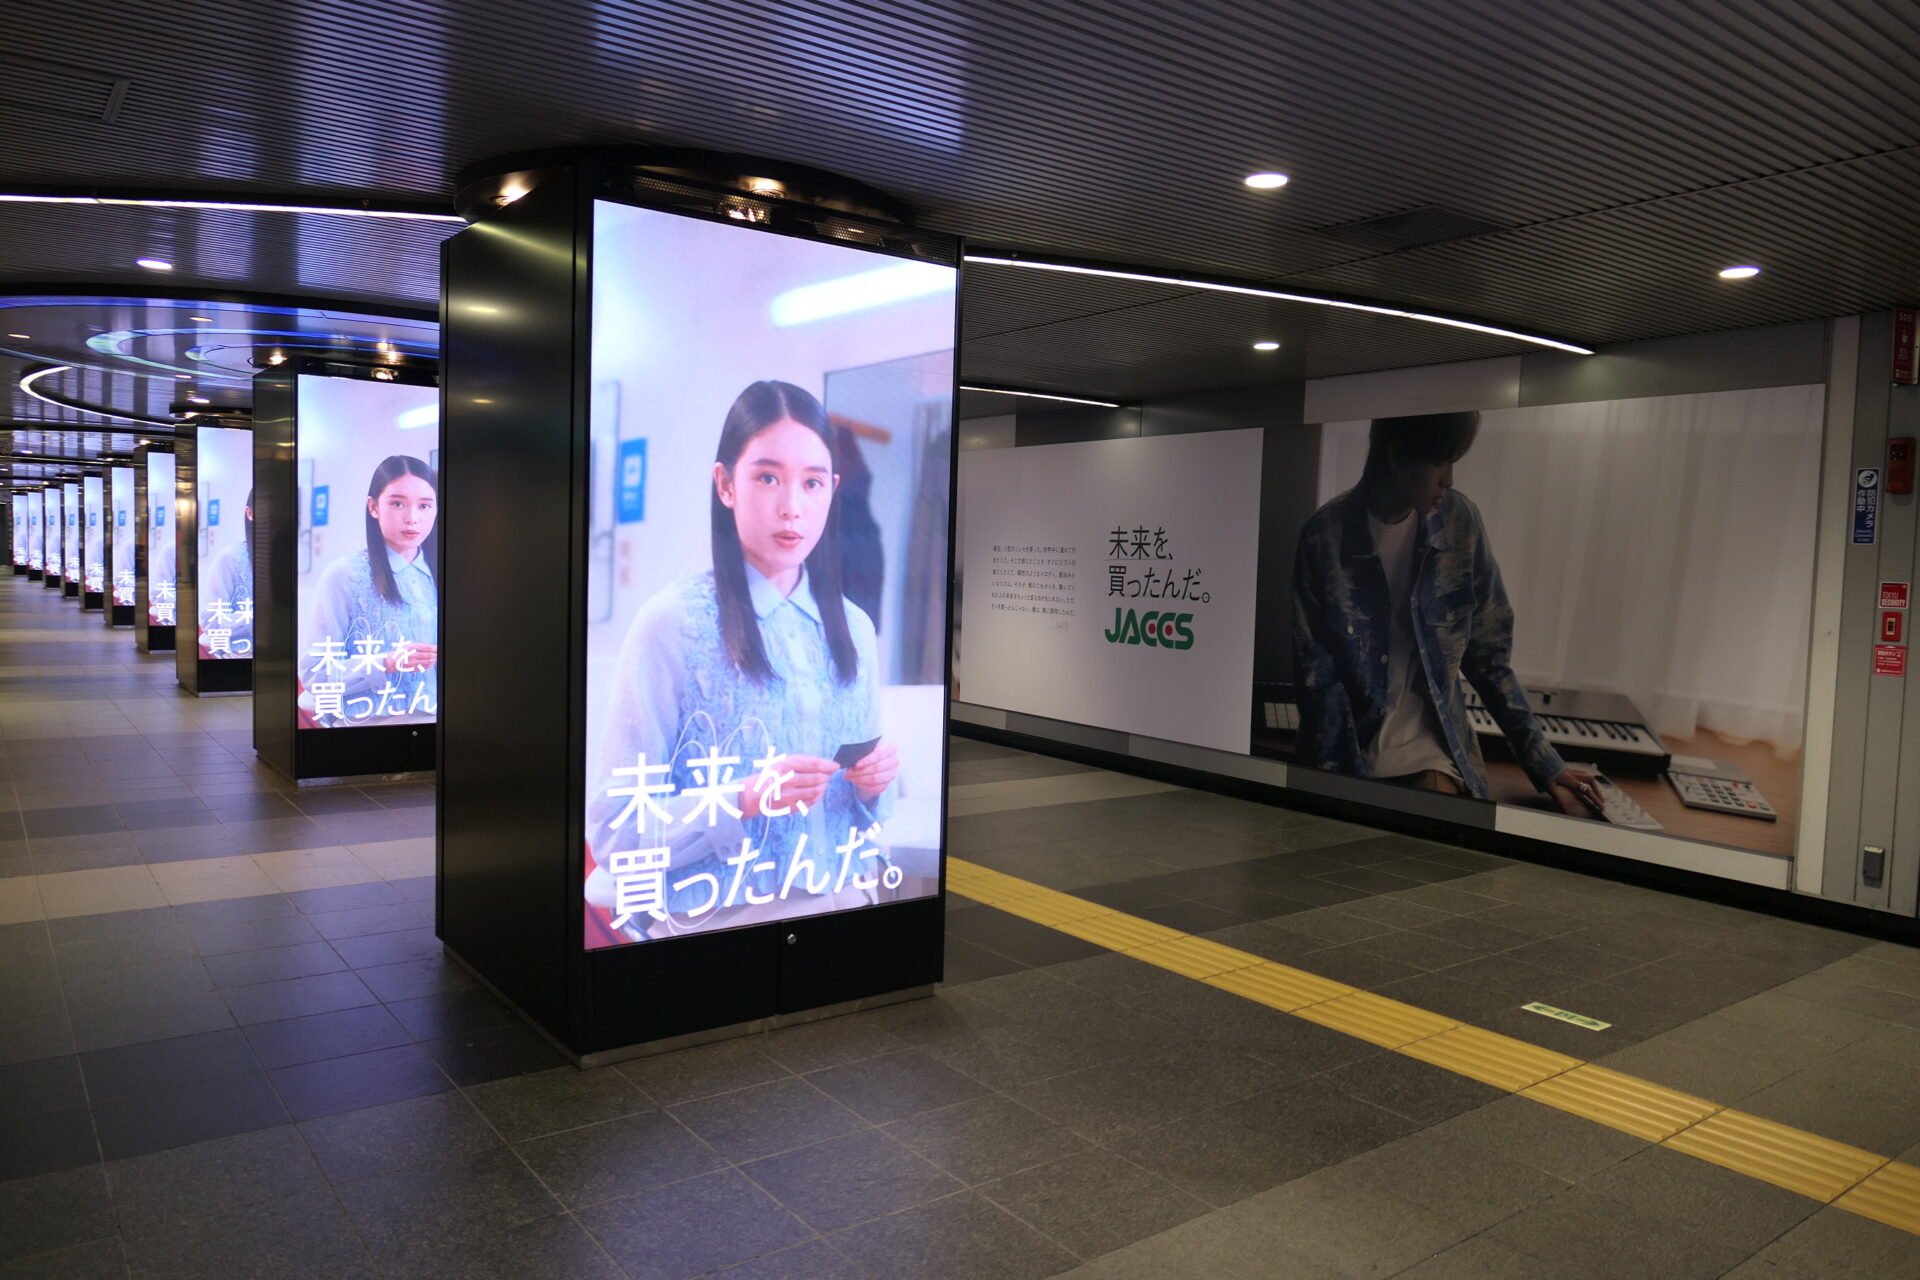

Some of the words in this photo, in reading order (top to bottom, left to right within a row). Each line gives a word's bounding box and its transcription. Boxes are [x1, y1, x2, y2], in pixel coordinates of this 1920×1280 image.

[1109, 525, 1173, 560] 未来を、
[1108, 565, 1210, 604] 買ったんだ。
[1881, 598, 1906, 607] SECURITY
[1104, 607, 1194, 650] JACCS
[310, 634, 427, 676] 未来を、
[607, 746, 809, 834] 未来を、
[608, 821, 904, 931] 買ったんだ。
